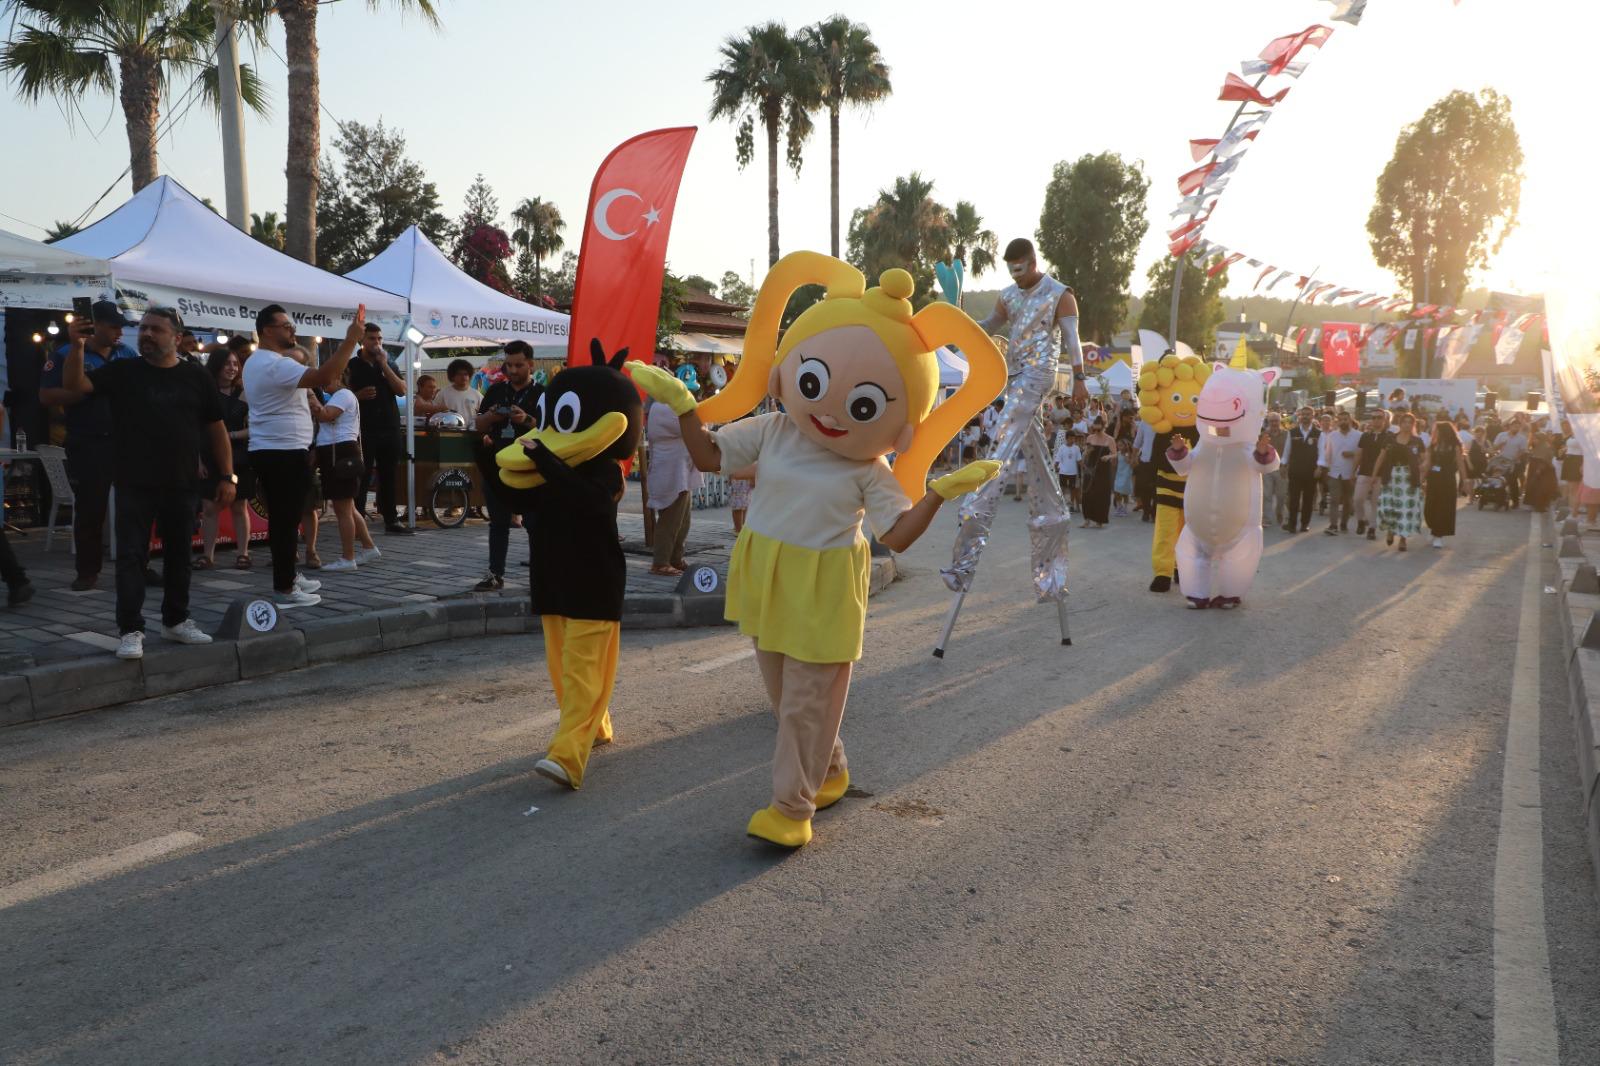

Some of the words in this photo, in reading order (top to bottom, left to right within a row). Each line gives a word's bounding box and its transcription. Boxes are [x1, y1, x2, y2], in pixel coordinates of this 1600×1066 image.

[177, 298, 236, 318] Şişhane
[292, 312, 332, 327] Waffle
[451, 315, 509, 330] T.C.ARSUZ
